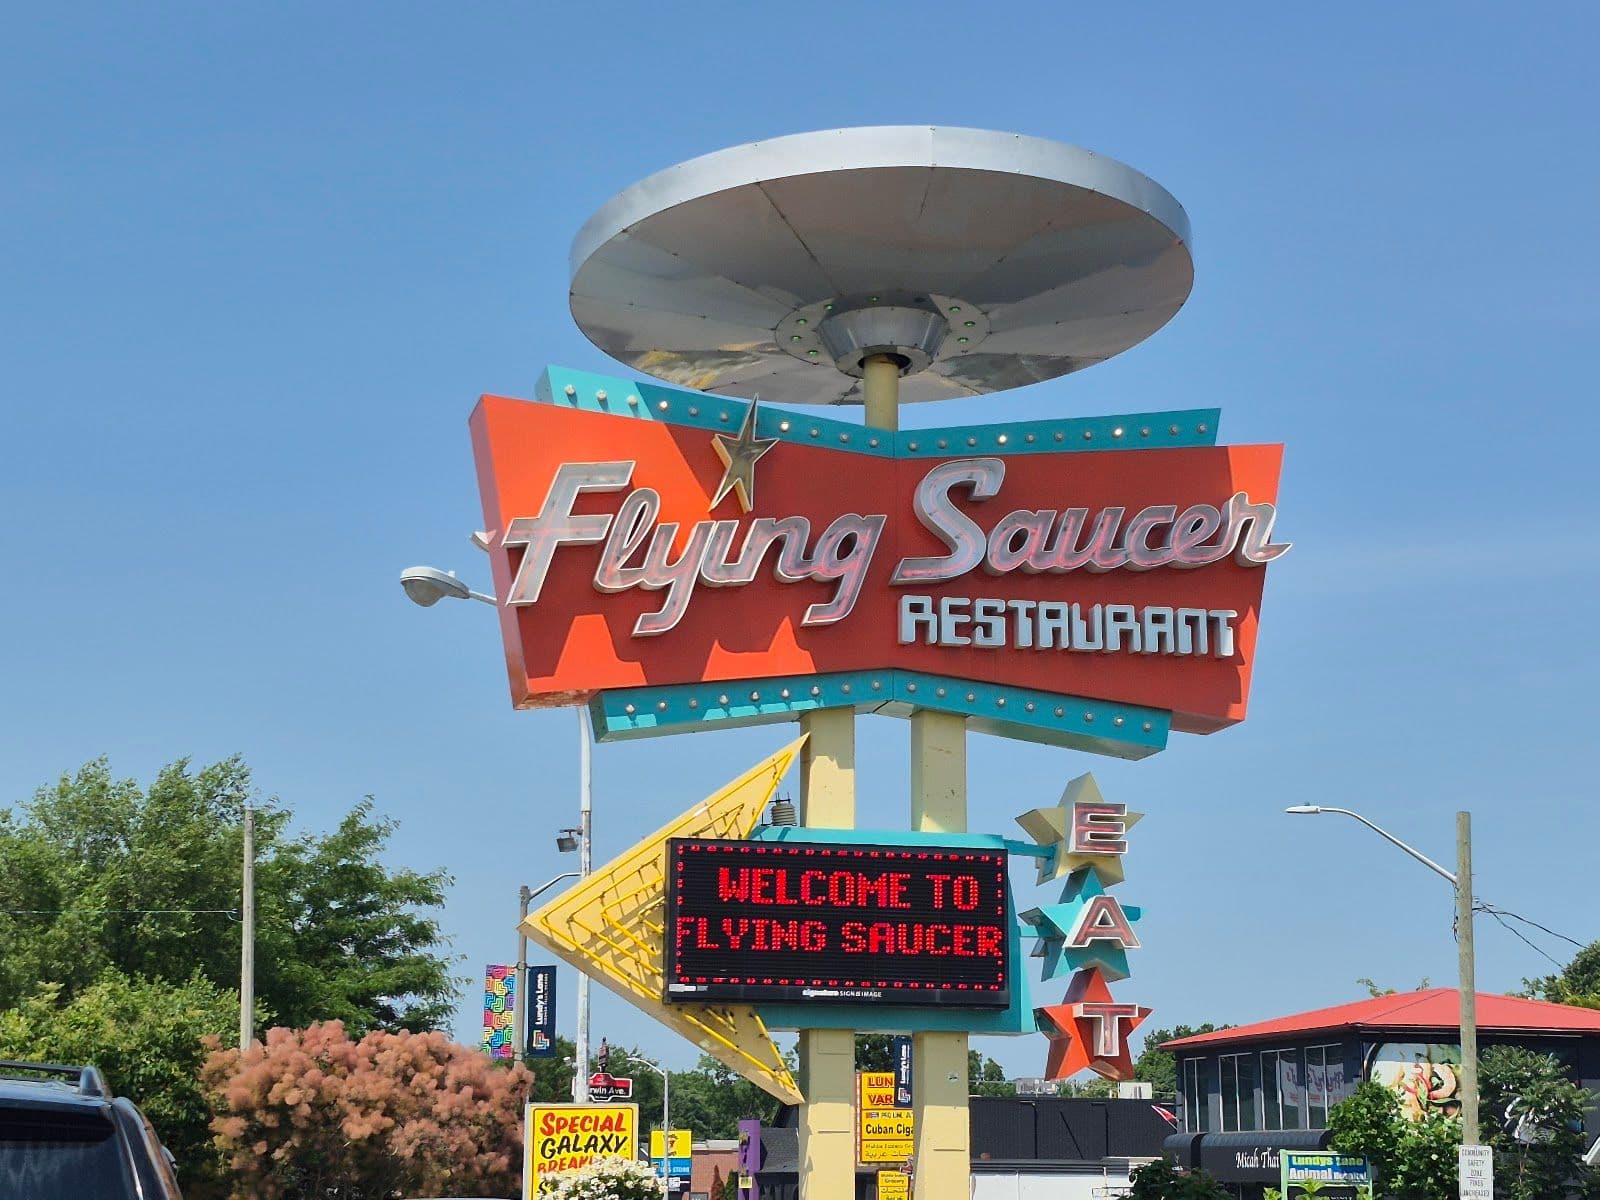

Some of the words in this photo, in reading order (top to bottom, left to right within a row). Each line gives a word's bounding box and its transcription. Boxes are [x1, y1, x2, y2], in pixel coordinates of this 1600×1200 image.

[889, 457, 1292, 586] Saucer
[501, 455, 888, 638] Flying
[898, 594, 1238, 658] RESTAURANT
[717, 866, 912, 909] WELCOME
[927, 872, 980, 911] TO
[676, 916, 828, 952] FLYING
[841, 922, 1004, 957] SAUCER
[535, 973, 545, 994] Lane
[861, 990, 882, 998] IMAGE
[534, 994, 545, 1026] Lundy's
[589, 1086, 607, 1095] rwin
[608, 1086, 626, 1095] Ave.
[867, 1075, 894, 1088] LUN
[867, 1093, 894, 1105] VAR
[539, 1112, 627, 1136] SPECIAL
[864, 1123, 894, 1135] Cuban
[540, 1133, 628, 1159] GALAXY
[1461, 1148, 1490, 1158] COMMUNITY
[537, 1154, 594, 1174] BREAK
[1235, 1147, 1259, 1169] Micah
[1260, 1146, 1280, 1169] Thai
[1291, 1155, 1334, 1167] Lundys
[1335, 1155, 1364, 1167] Lane
[1467, 1159, 1485, 1167] SAFETY
[1289, 1167, 1332, 1180] Animal
